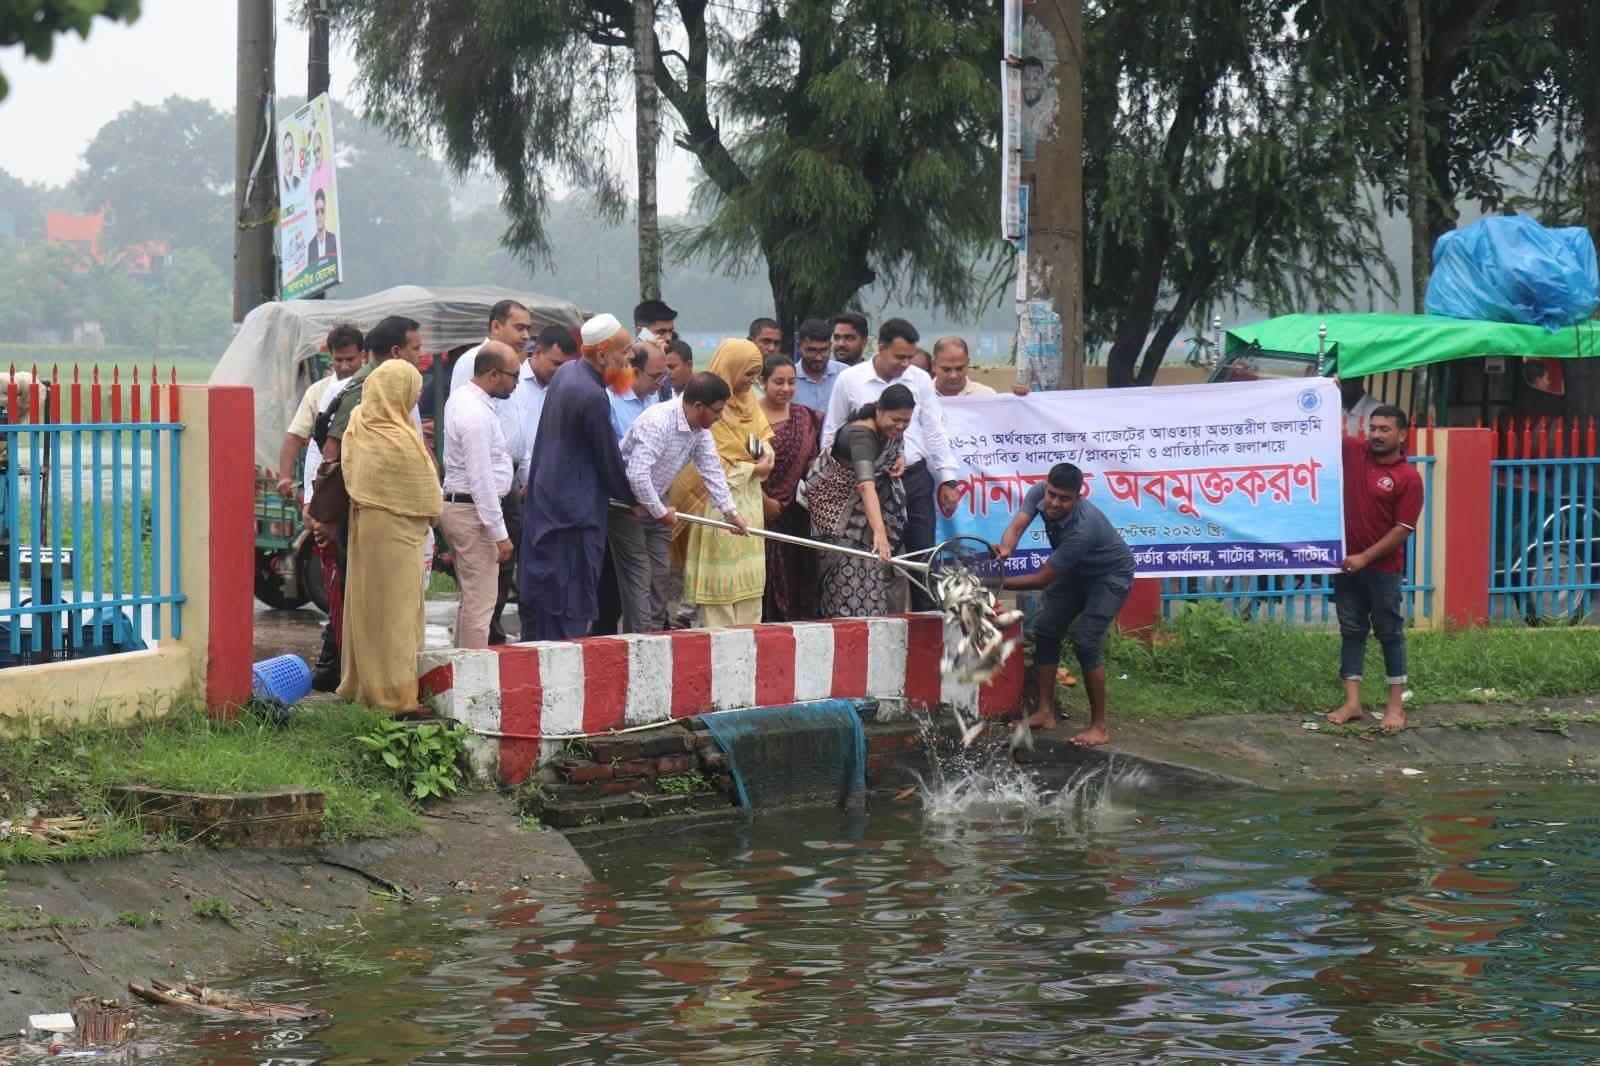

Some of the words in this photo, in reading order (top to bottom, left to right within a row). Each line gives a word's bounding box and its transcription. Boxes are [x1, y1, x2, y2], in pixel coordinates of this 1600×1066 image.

[992, 429, 1048, 446] অর্থবছরে
[1052, 431, 1088, 445] রাজস্ব
[1092, 426, 1145, 444] বাজেটের
[1150, 425, 1202, 440] আওতায়
[1206, 418, 1267, 437] অভ্যন্তরীণ
[1271, 416, 1323, 436] জলাভূমি
[1147, 446, 1157, 458] ও
[1161, 440, 1231, 459] প্রাতিষ্ঠানিক
[1234, 439, 1287, 454] জলাশয়ে
[1103, 456, 1323, 520] অবমুক্তকরণ
[1163, 525, 1201, 537] ২০২৬
[1167, 545, 1215, 567] কার্যালয়,
[1218, 546, 1254, 564] নাটোর
[1257, 547, 1288, 565] সদর,
